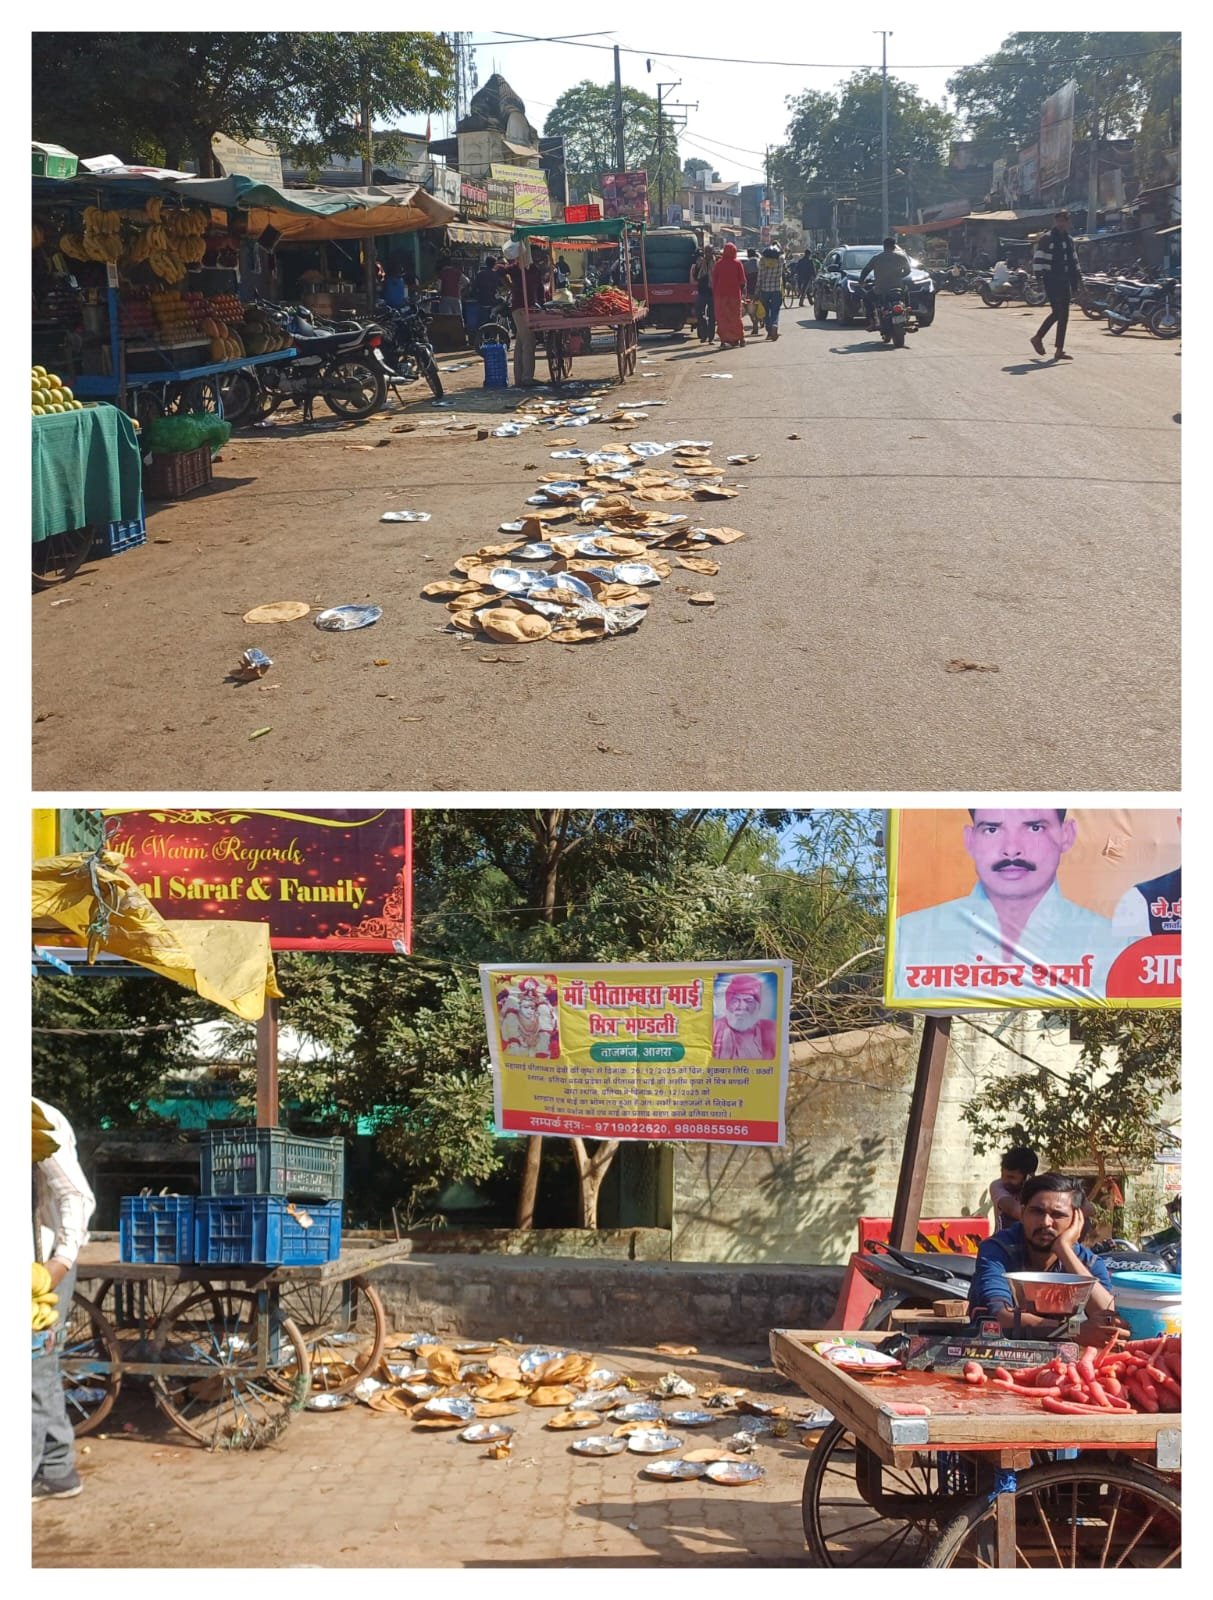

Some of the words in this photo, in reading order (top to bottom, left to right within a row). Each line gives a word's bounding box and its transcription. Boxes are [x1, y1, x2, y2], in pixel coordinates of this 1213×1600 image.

[141, 834, 207, 860] Warm
[139, 876, 162, 899] al
[168, 876, 244, 900] Saraf
[246, 877, 272, 901] &
[278, 877, 367, 909] Family
[905, 954, 1025, 989] रमाशंकर
[1029, 954, 1094, 989] शर्मा
[1137, 955, 1182, 985] आ
[588, 980, 665, 1009] पीताम्बरा
[667, 979, 703, 1010] माई
[624, 1013, 678, 1035] मण्डली
[642, 1046, 673, 1057] आगरा
[530, 1116, 561, 1128] सम्पर्क
[674, 1123, 749, 1136] 9808855956
[963, 1347, 993, 1359] M.J.
